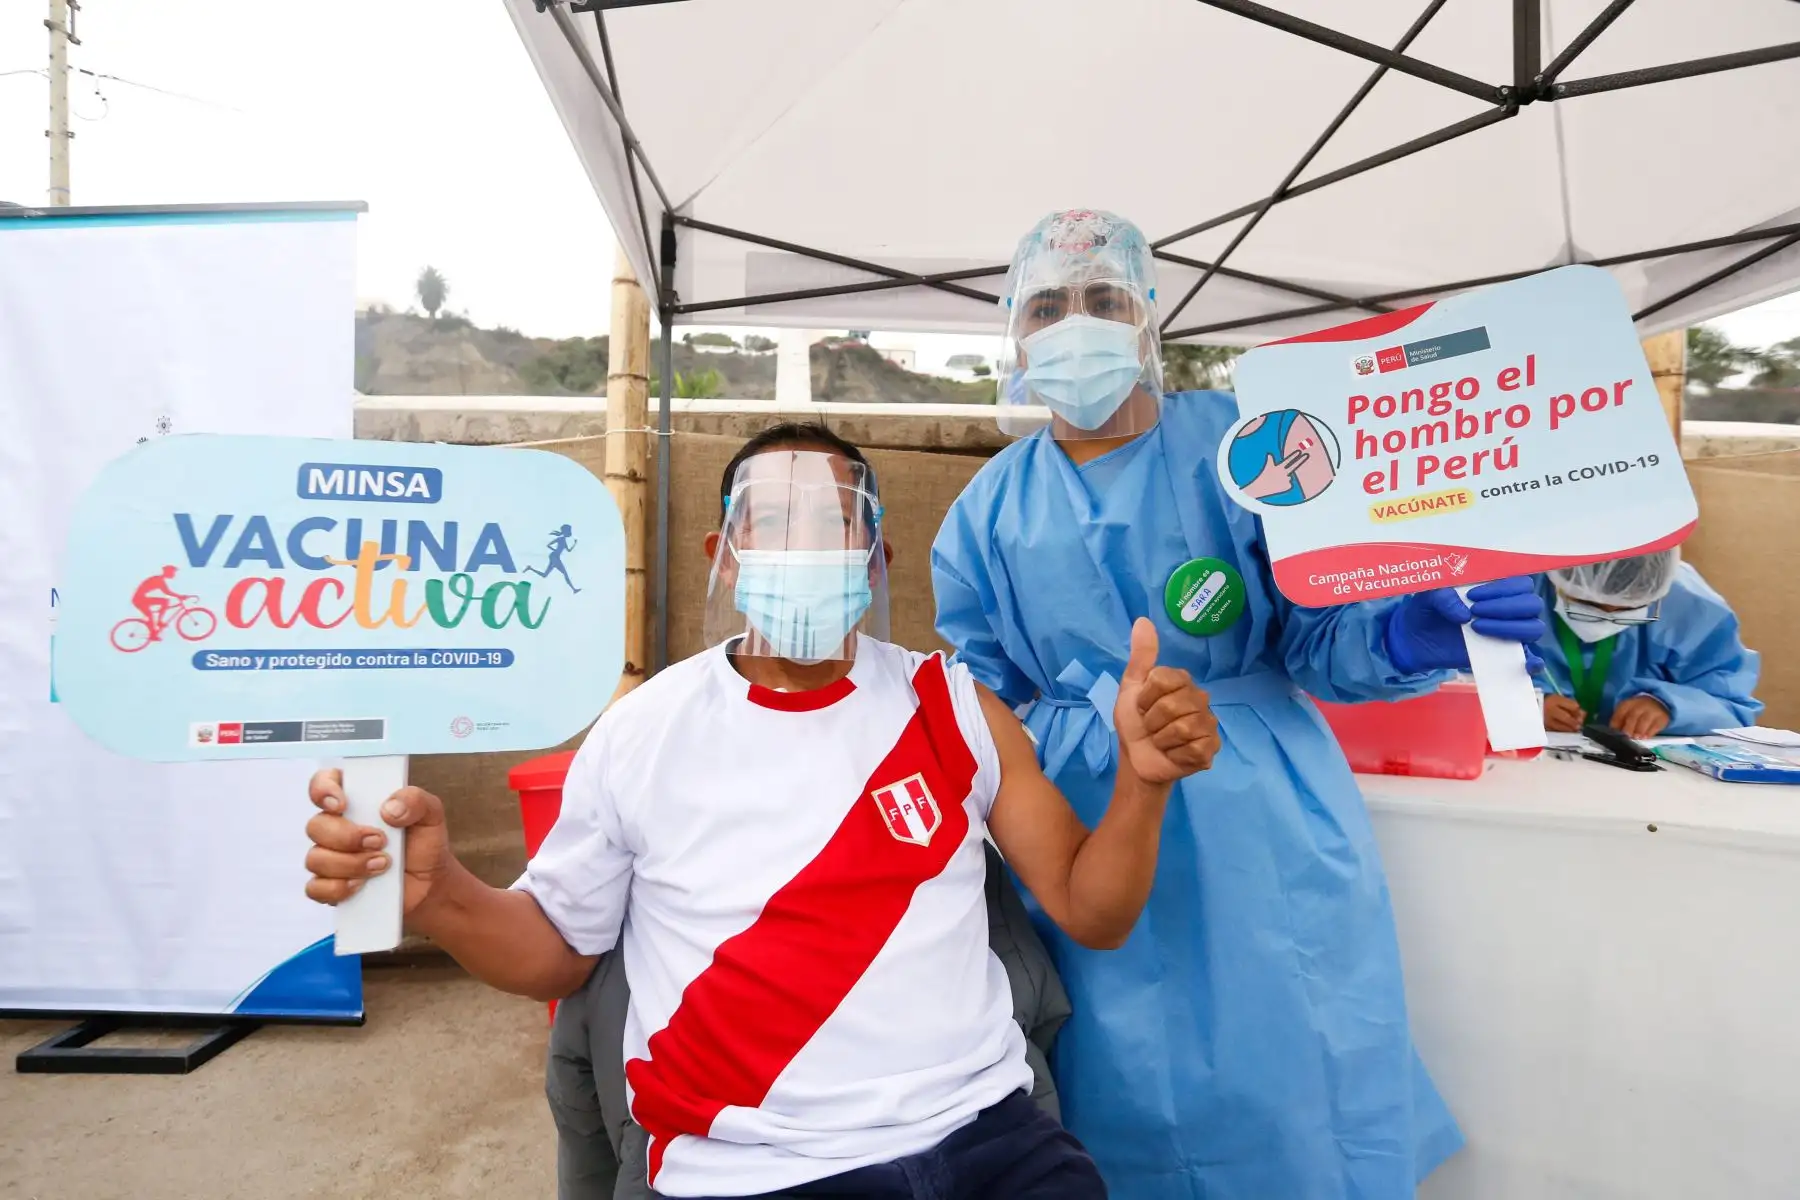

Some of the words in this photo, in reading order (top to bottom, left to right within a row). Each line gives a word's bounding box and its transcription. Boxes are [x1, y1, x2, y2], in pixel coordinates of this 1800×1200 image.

[1380, 353, 1402, 365] PERÚ
[1409, 345, 1441, 357] Ministerio
[1420, 352, 1438, 361] Salud
[1347, 376, 1480, 425] Pongo
[1496, 354, 1536, 391] el
[1355, 403, 1531, 460] hombro
[1549, 378, 1633, 431] por
[1362, 459, 1398, 495] el
[1416, 436, 1519, 487] Perú
[307, 468, 431, 498] MINSA
[1373, 492, 1468, 519] VACÚNATE
[1480, 479, 1541, 499] contra
[1546, 474, 1563, 488] la
[1568, 453, 1660, 483] COVID-19
[173, 513, 517, 573] VACUNA
[225, 540, 552, 630] activa
[1308, 567, 1375, 587] Campaña
[1378, 554, 1443, 575] Nacional
[1333, 583, 1351, 595] de
[1354, 570, 1441, 592] Vacunación
[1176, 598, 1185, 607] Mi
[1183, 577, 1203, 600] nombre
[1202, 569, 1210, 578] es
[1191, 588, 1212, 611] SARA
[206, 653, 251, 668] Sano
[255, 656, 264, 669] y
[269, 653, 352, 669] protegido
[356, 653, 409, 666] contra
[414, 652, 427, 666] la
[431, 651, 502, 666] COVID-19
